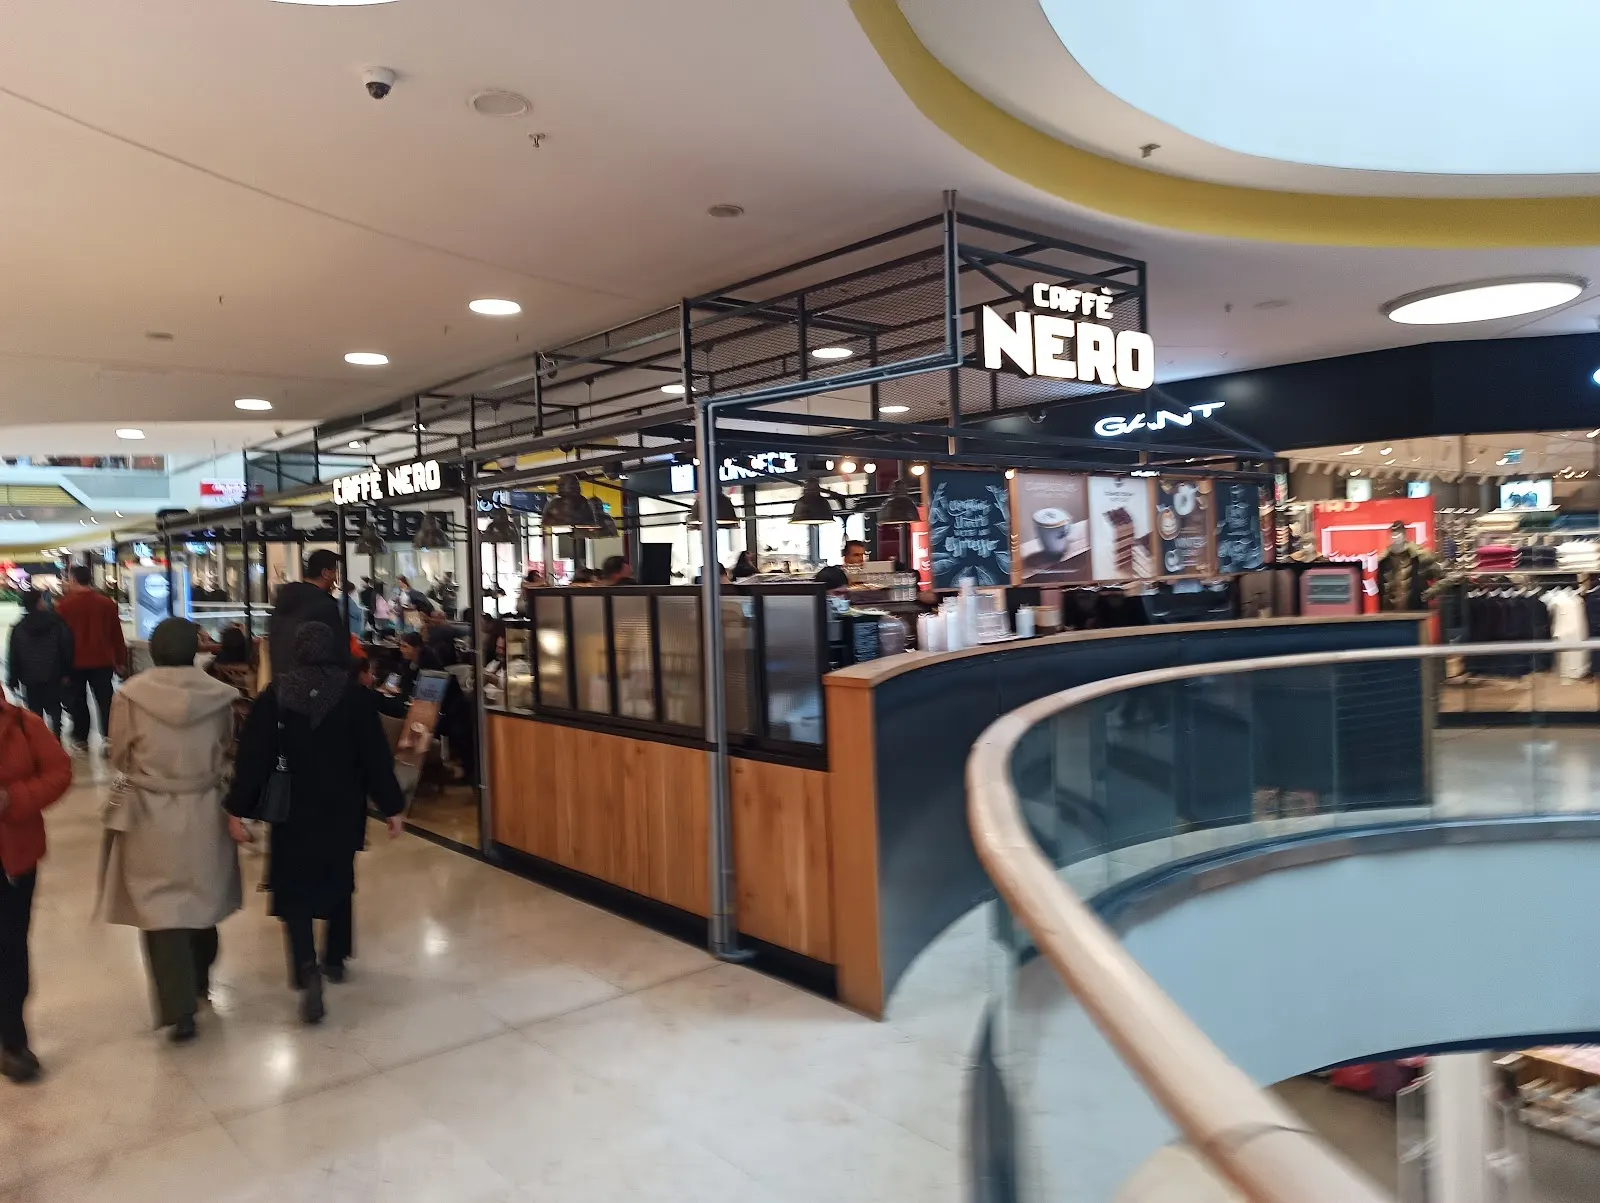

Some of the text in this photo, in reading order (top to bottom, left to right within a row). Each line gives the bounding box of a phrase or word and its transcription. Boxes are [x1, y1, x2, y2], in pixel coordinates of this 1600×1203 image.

[1033, 282, 1114, 320] CAFFÈ
[982, 305, 1155, 390] NERO
[1094, 401, 1226, 437] GANT
[333, 459, 441, 506] CAFFÈ NERO
